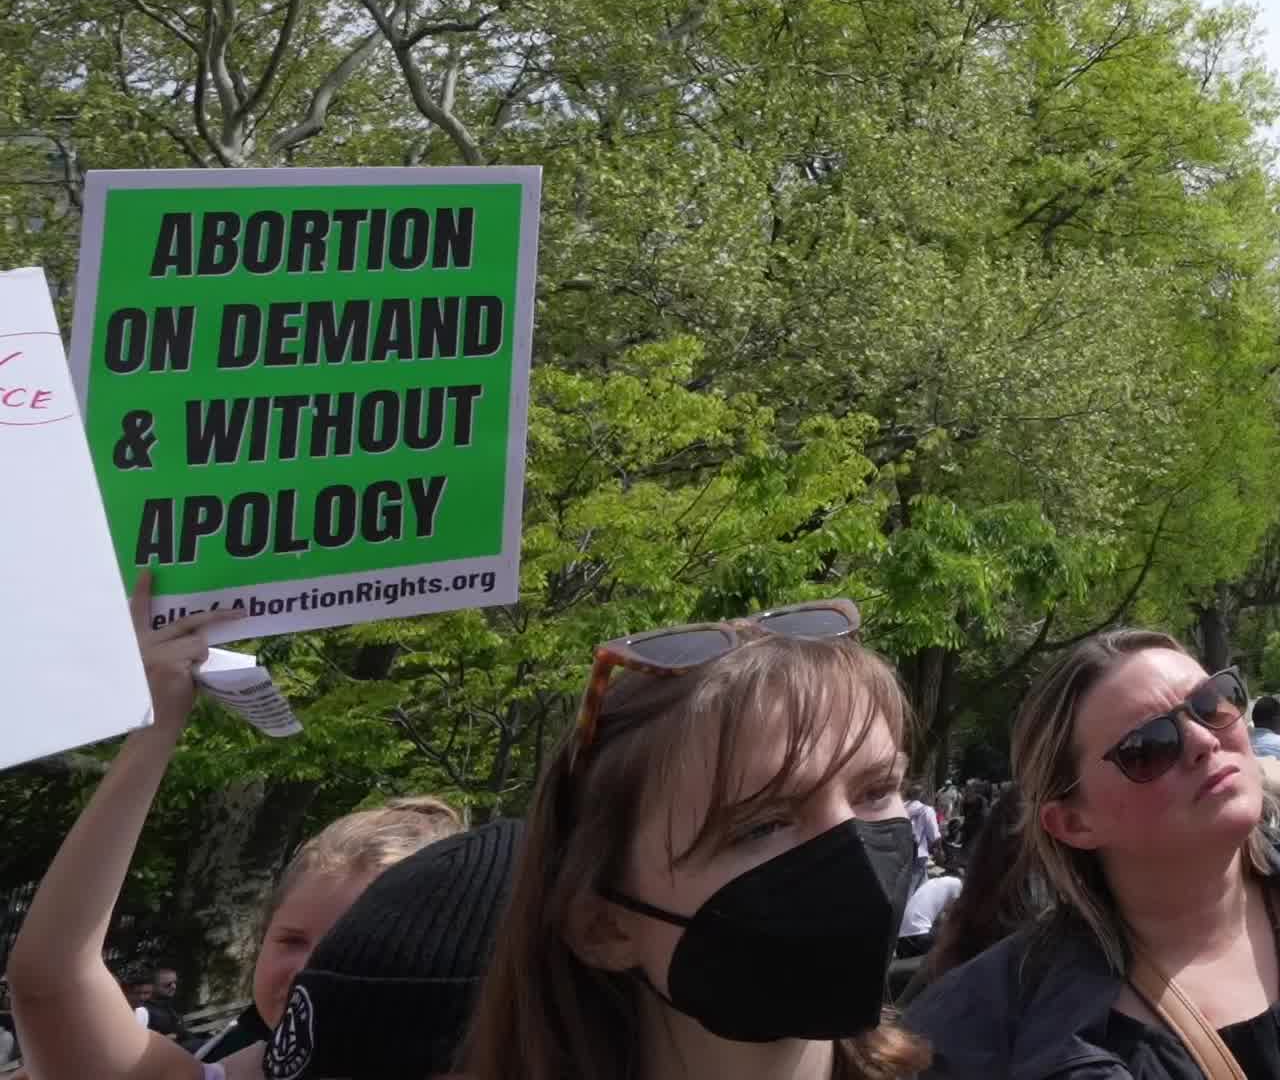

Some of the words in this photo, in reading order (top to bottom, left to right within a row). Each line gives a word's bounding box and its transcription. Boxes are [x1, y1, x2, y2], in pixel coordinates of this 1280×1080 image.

[150, 206, 474, 277] ABORTION
[104, 305, 195, 373] ON
[217, 295, 503, 369] DEMAND
[0, 386, 52, 409] CE
[112, 409, 158, 469] &
[185, 385, 482, 465] WITHOUT
[135, 476, 447, 566] APOLOGY
